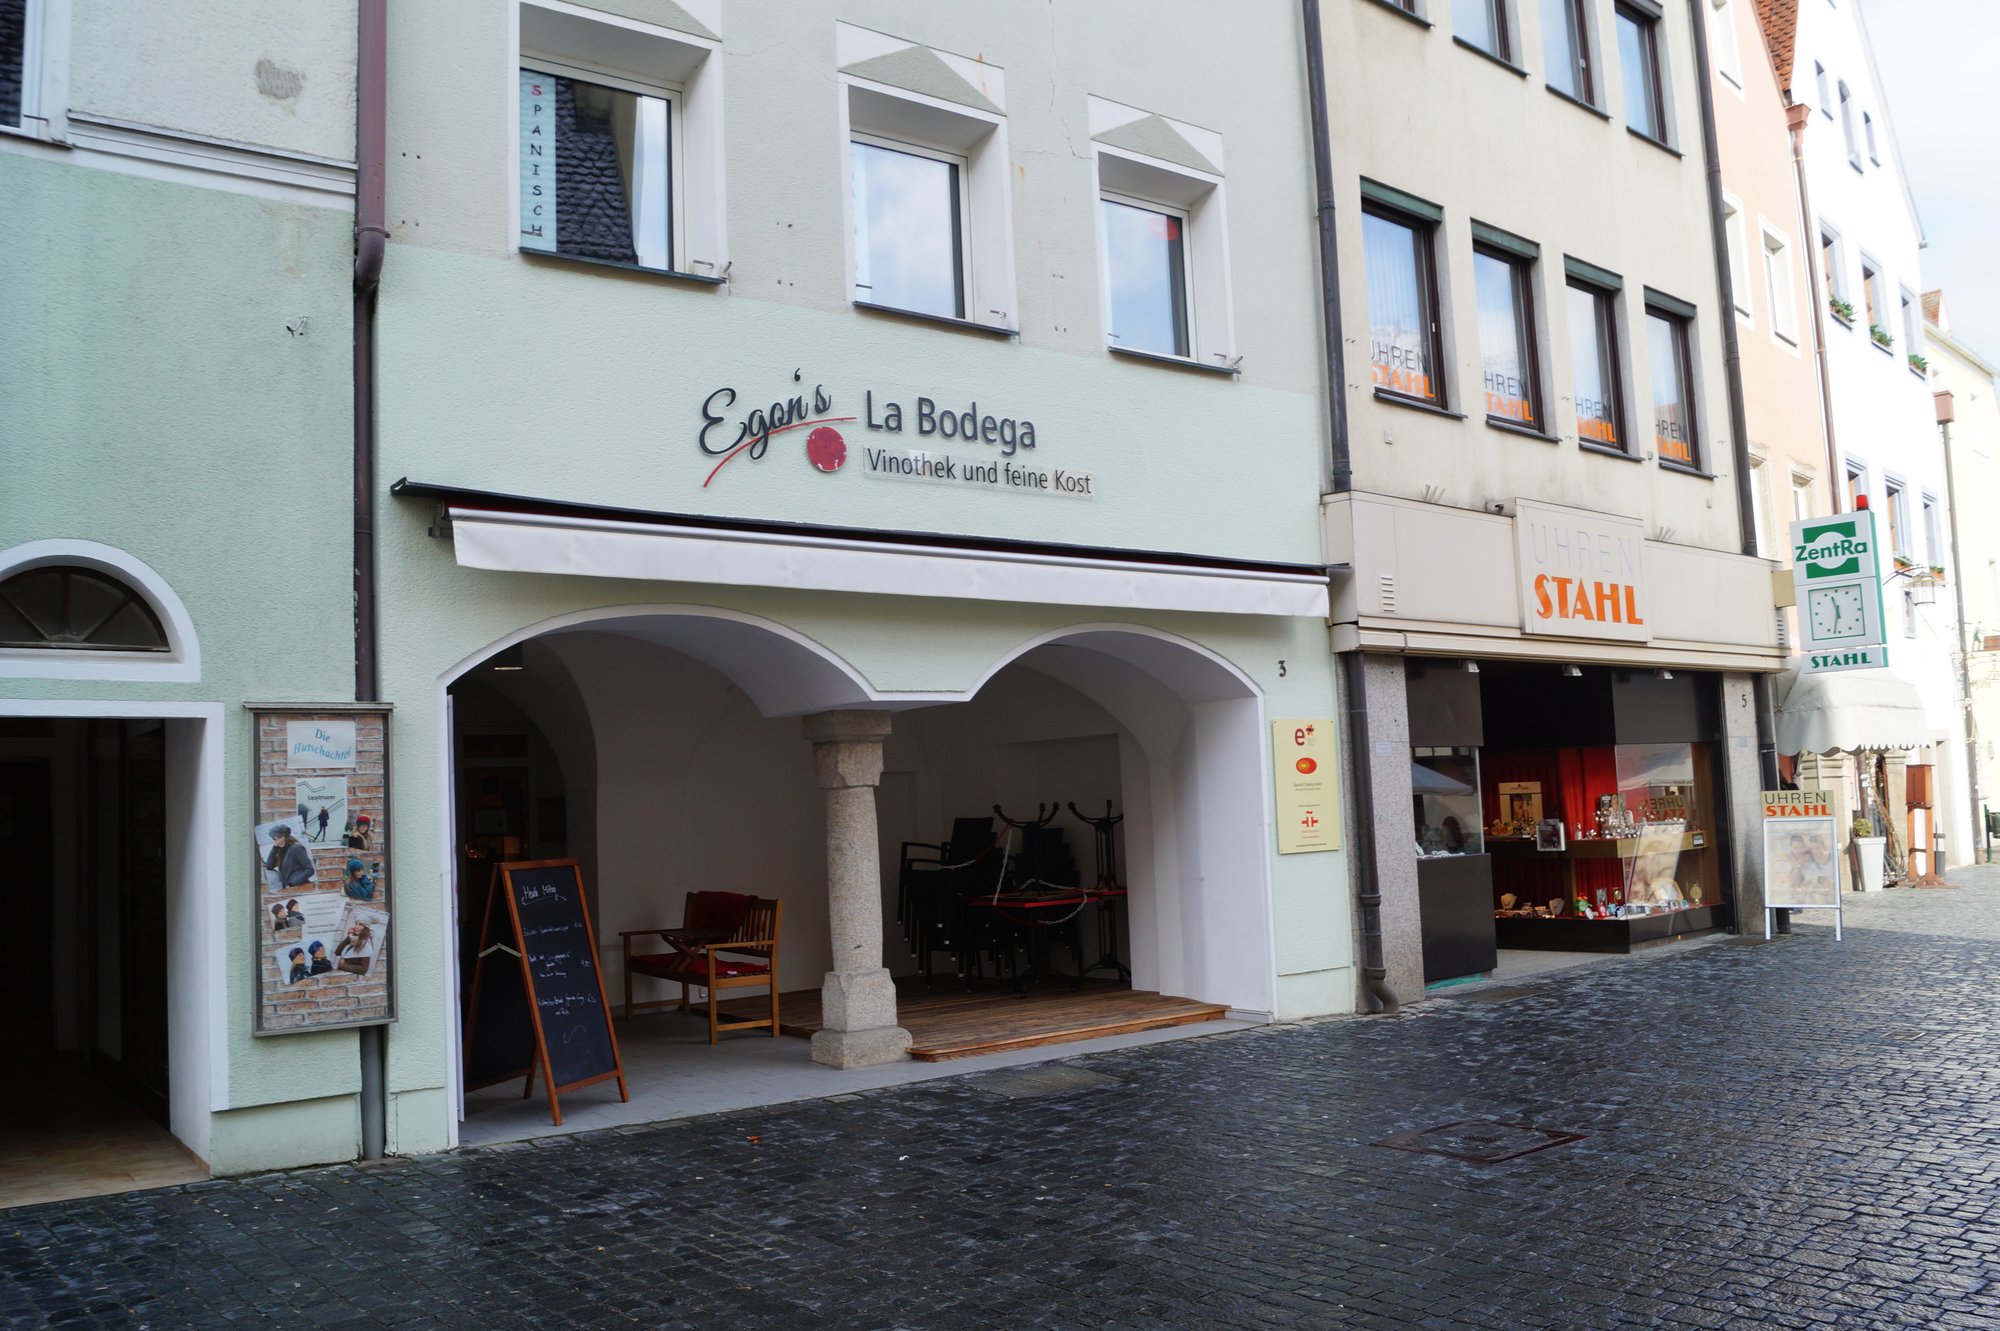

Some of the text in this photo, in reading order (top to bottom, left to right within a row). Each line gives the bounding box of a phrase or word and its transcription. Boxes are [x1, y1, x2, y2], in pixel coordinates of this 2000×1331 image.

[530, 85, 543, 234] SPANISCH
[699, 368, 1036, 460] Egon's La Bodega
[868, 448, 1092, 495] Vinothek und feine Kost
[1531, 523, 1633, 577] UHREN
[1795, 539, 1868, 562] ZentRa
[1533, 573, 1644, 625] STAHL
[1277, 660, 1287, 678] 3
[1811, 652, 1872, 669] STAHL
[1741, 694, 1747, 708] 5
[315, 729, 331, 742] Die
[293, 743, 352, 760] Hutschachtel
[1764, 792, 1827, 805] UHREN
[1766, 804, 1832, 817] STAHL
